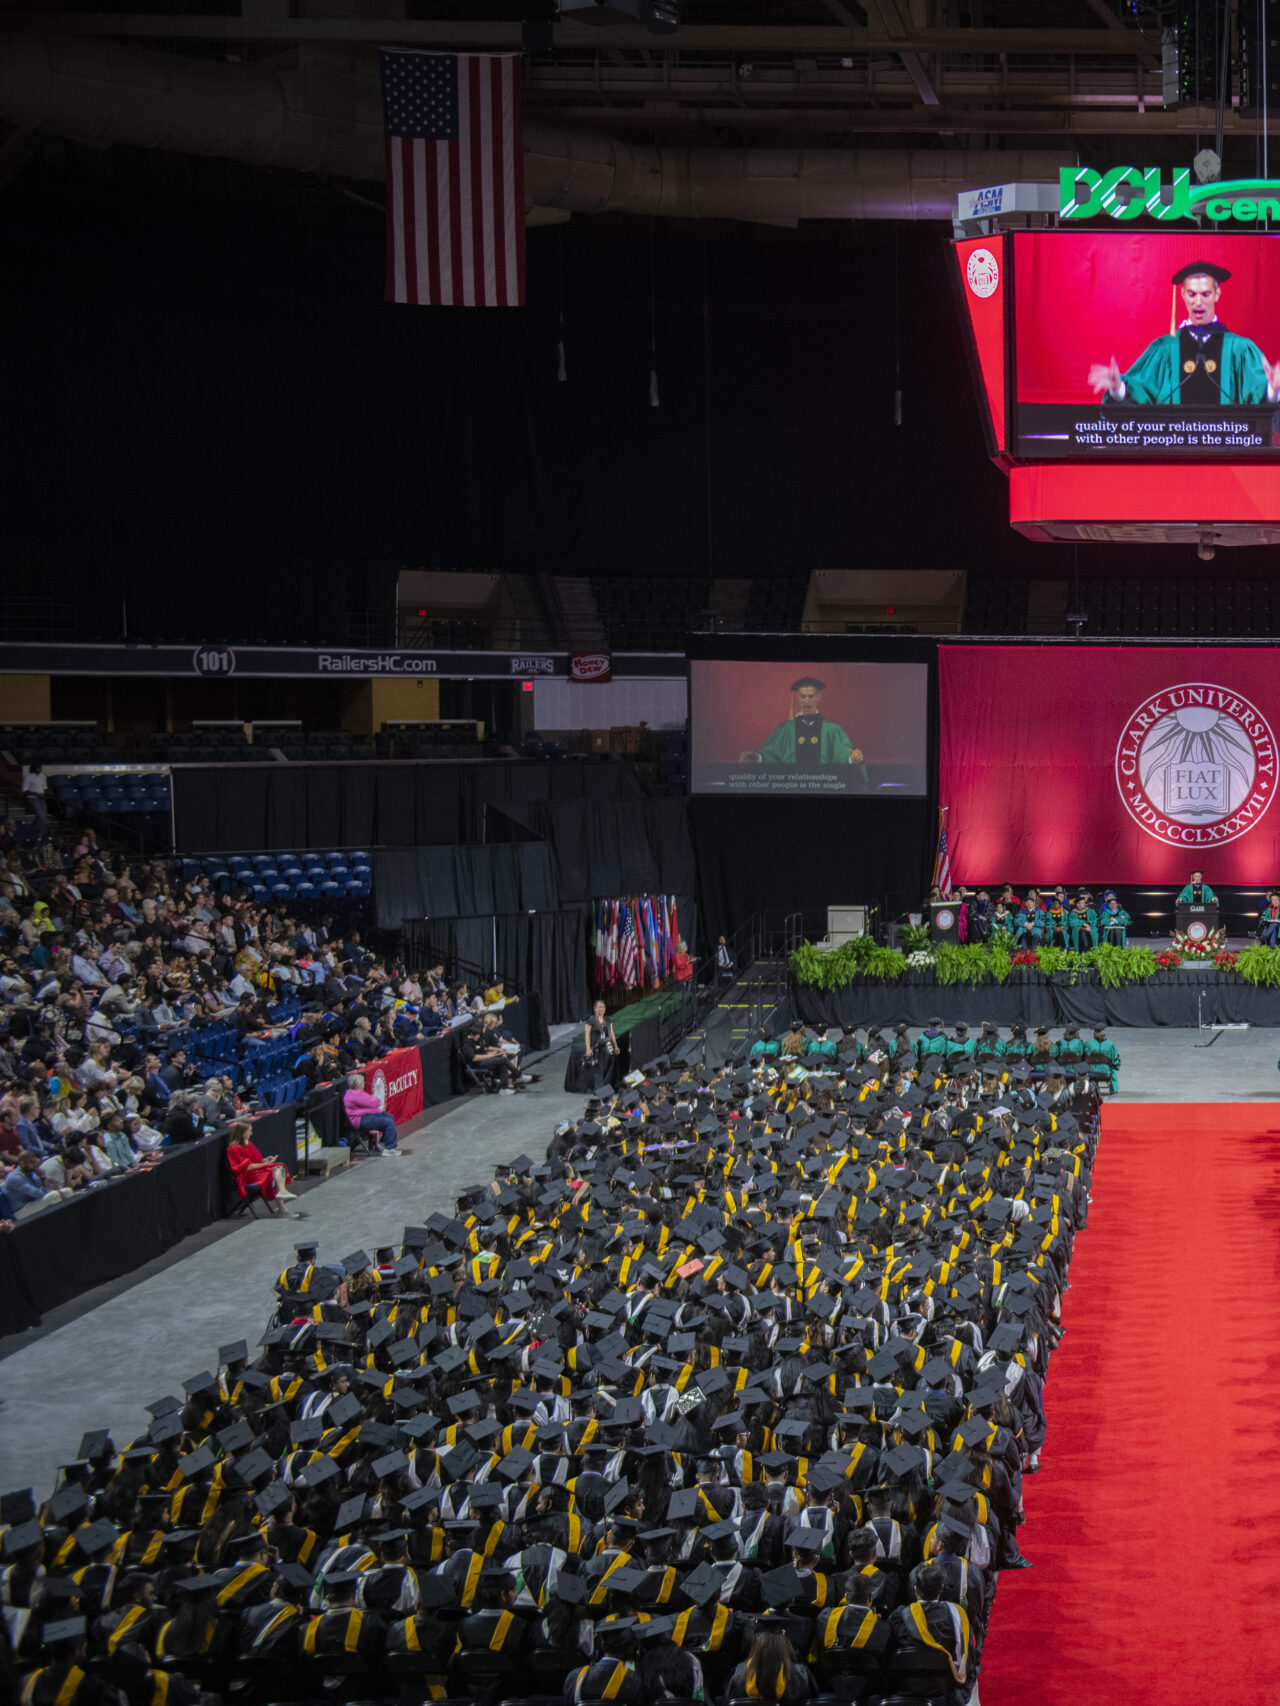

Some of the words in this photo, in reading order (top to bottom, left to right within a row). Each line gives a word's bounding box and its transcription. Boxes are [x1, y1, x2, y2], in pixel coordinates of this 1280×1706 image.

[974, 188, 1003, 210] ASM
[1060, 166, 1190, 220] DCU
[1075, 421, 1118, 433] quality
[1121, 421, 1135, 431] of
[1137, 423, 1165, 433] your
[1168, 421, 1249, 433] relationships
[1075, 433, 1103, 444] with
[1106, 433, 1140, 444] other
[1143, 434, 1184, 446] people
[1188, 434, 1198, 444] is
[1202, 434, 1221, 444] the
[1225, 434, 1262, 446] single
[200, 651, 229, 671] 101
[318, 655, 437, 672] RailersHC.com
[511, 659, 554, 673] RAILERS
[1120, 700, 1168, 776] CLARK
[1168, 688, 1274, 776] UNIVERSITY
[787, 774, 838, 782] relationships
[1175, 769, 1221, 784] FIAT
[823, 781, 846, 789] single
[1177, 786, 1219, 800] LUX
[1129, 792, 1266, 843] MDCCCLXXXVII
[389, 1069, 418, 1097] FACULTY
